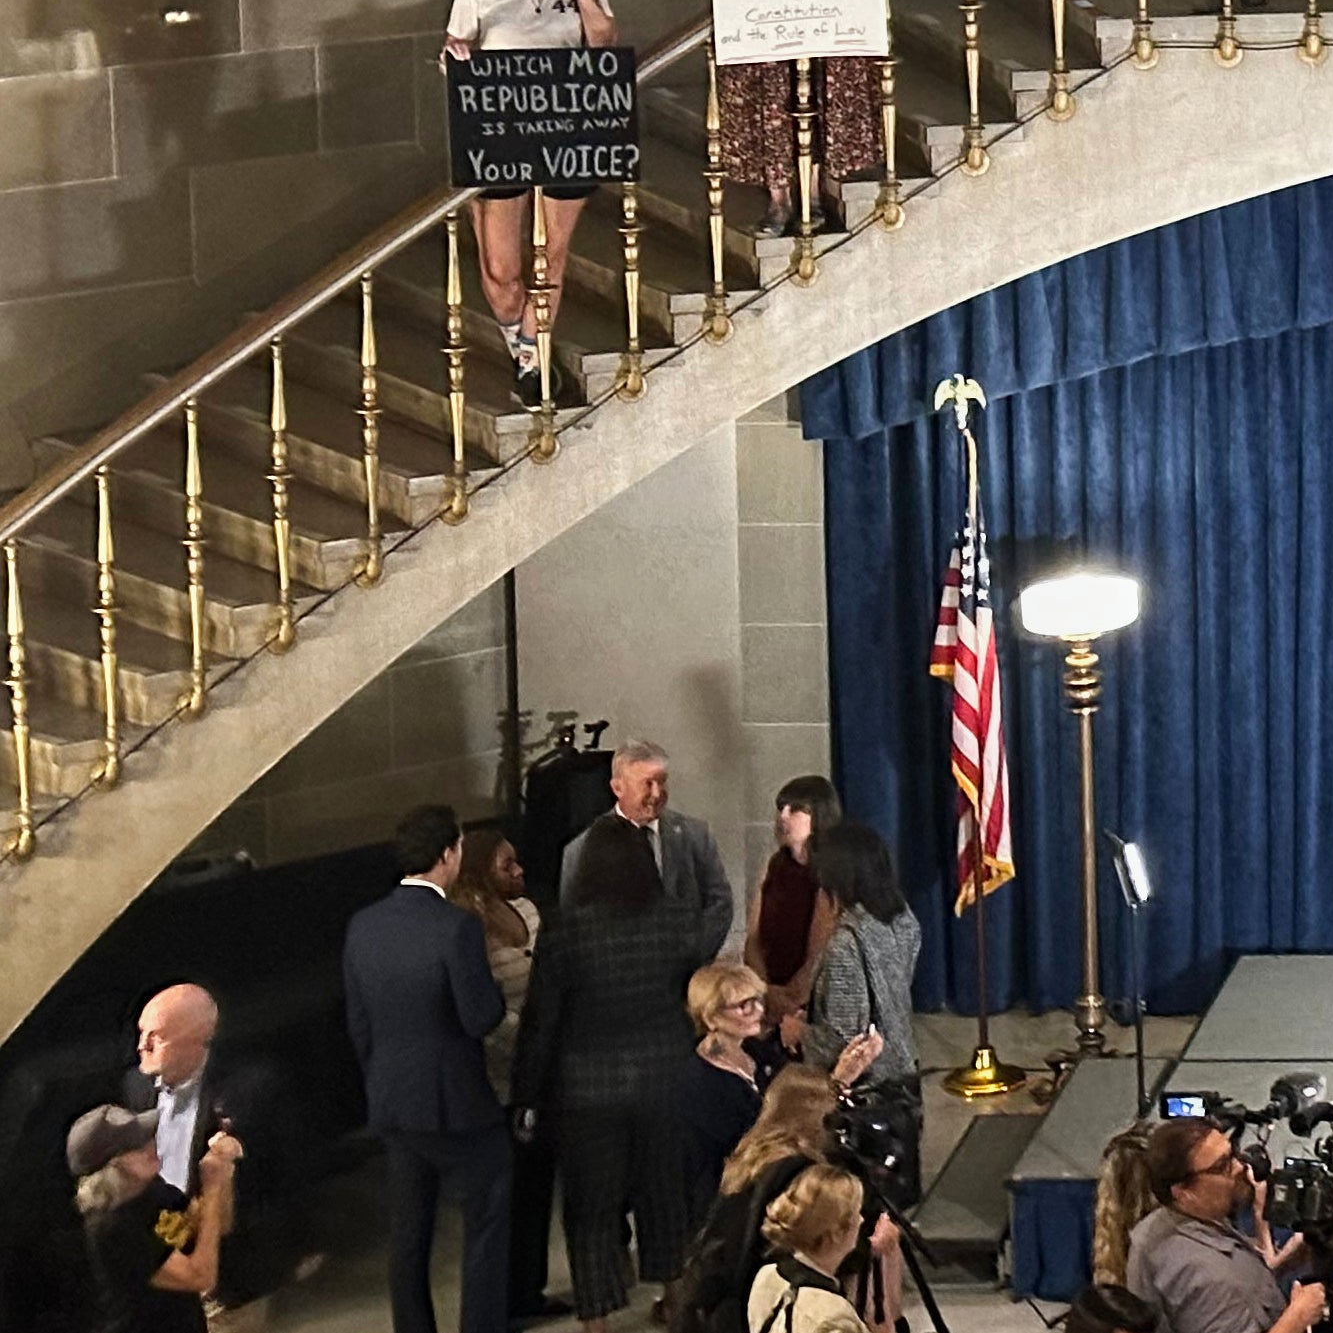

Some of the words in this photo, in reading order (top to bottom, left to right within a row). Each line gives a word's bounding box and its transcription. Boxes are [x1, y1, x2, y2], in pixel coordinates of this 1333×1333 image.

[745, 4, 843, 23] Constitution
[721, 30, 741, 45] and
[747, 28, 768, 41] the
[774, 24, 805, 41] Rule
[813, 22, 829, 36] of
[835, 22, 866, 36] Law
[470, 55, 553, 77] WHICH
[568, 50, 618, 76] MO
[458, 82, 633, 114] REPUBLICAN
[482, 122, 506, 136] IS
[514, 119, 575, 135] TAKING
[582, 117, 630, 130] AWAY
[543, 144, 640, 179] VOICE?
